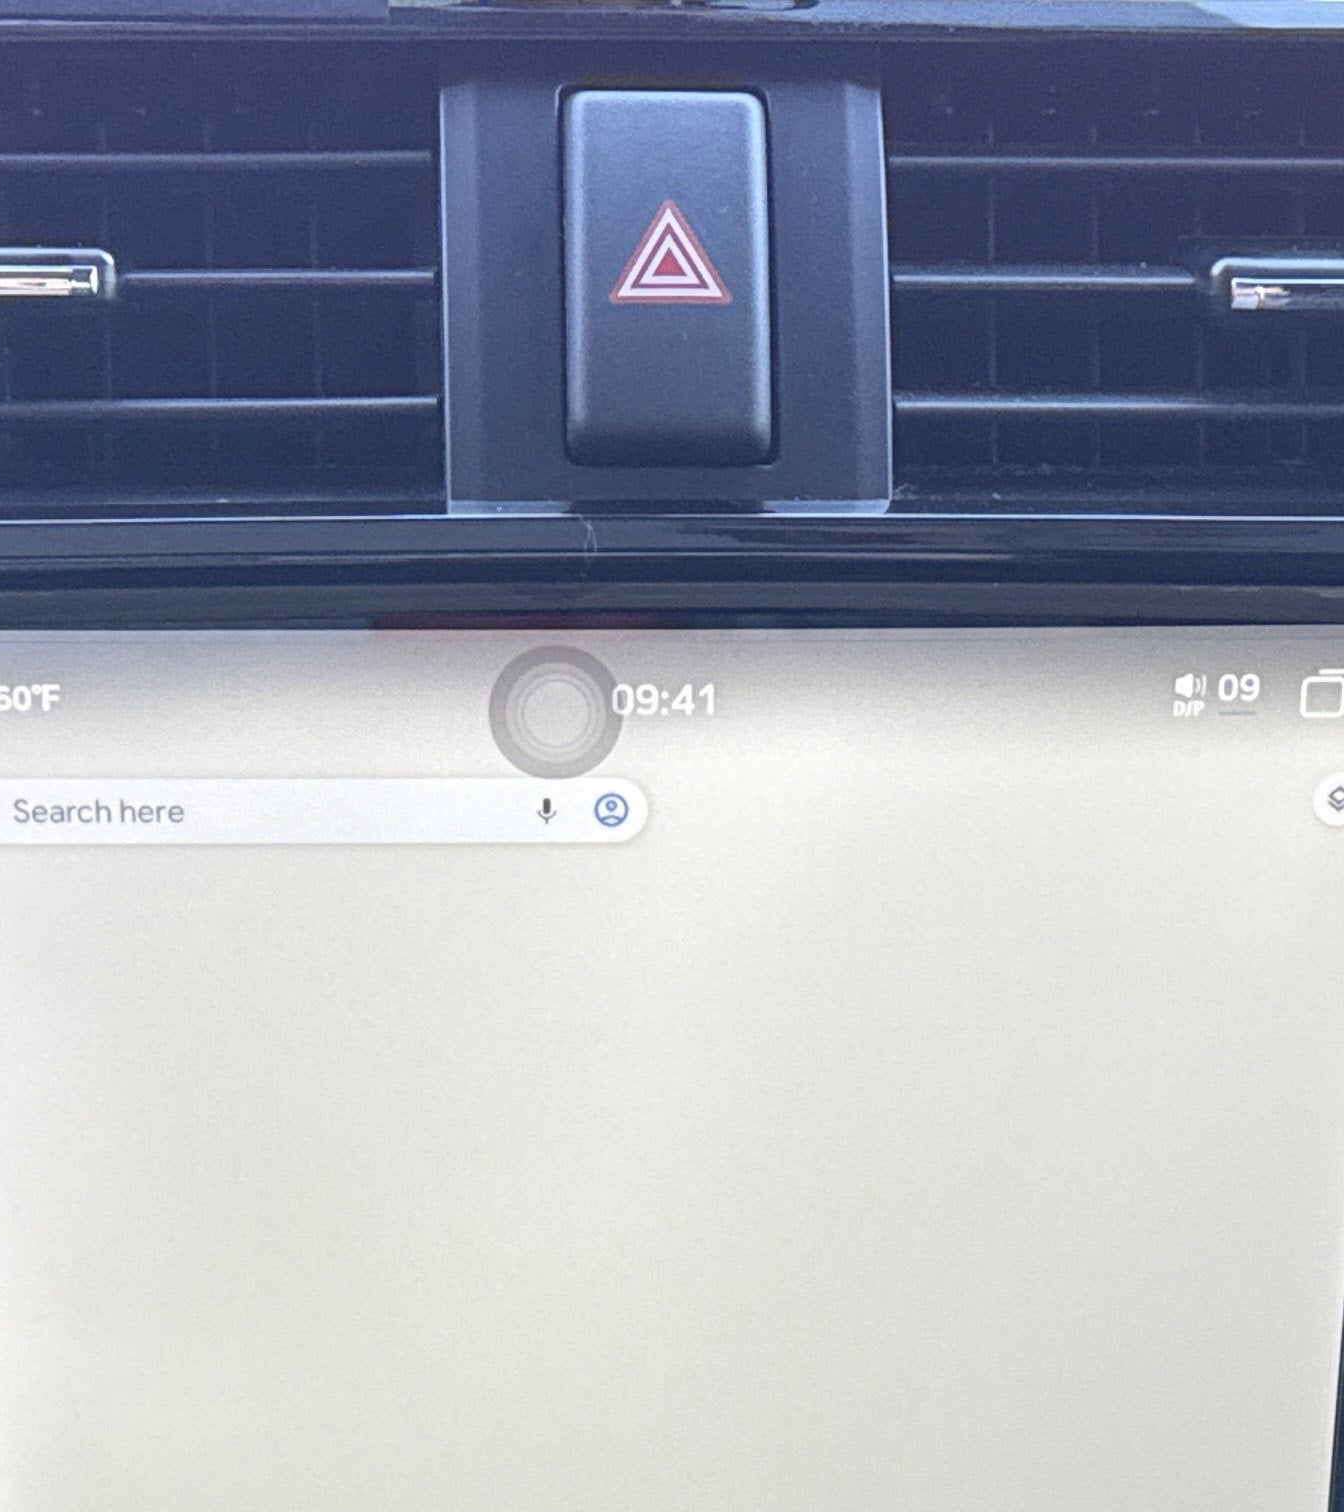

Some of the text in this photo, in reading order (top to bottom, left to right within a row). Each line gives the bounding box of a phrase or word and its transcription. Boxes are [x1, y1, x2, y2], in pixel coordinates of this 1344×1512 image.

[612, 683, 715, 716] 09:41
[1218, 673, 1260, 701] 09
[13, 799, 185, 824] Search here
